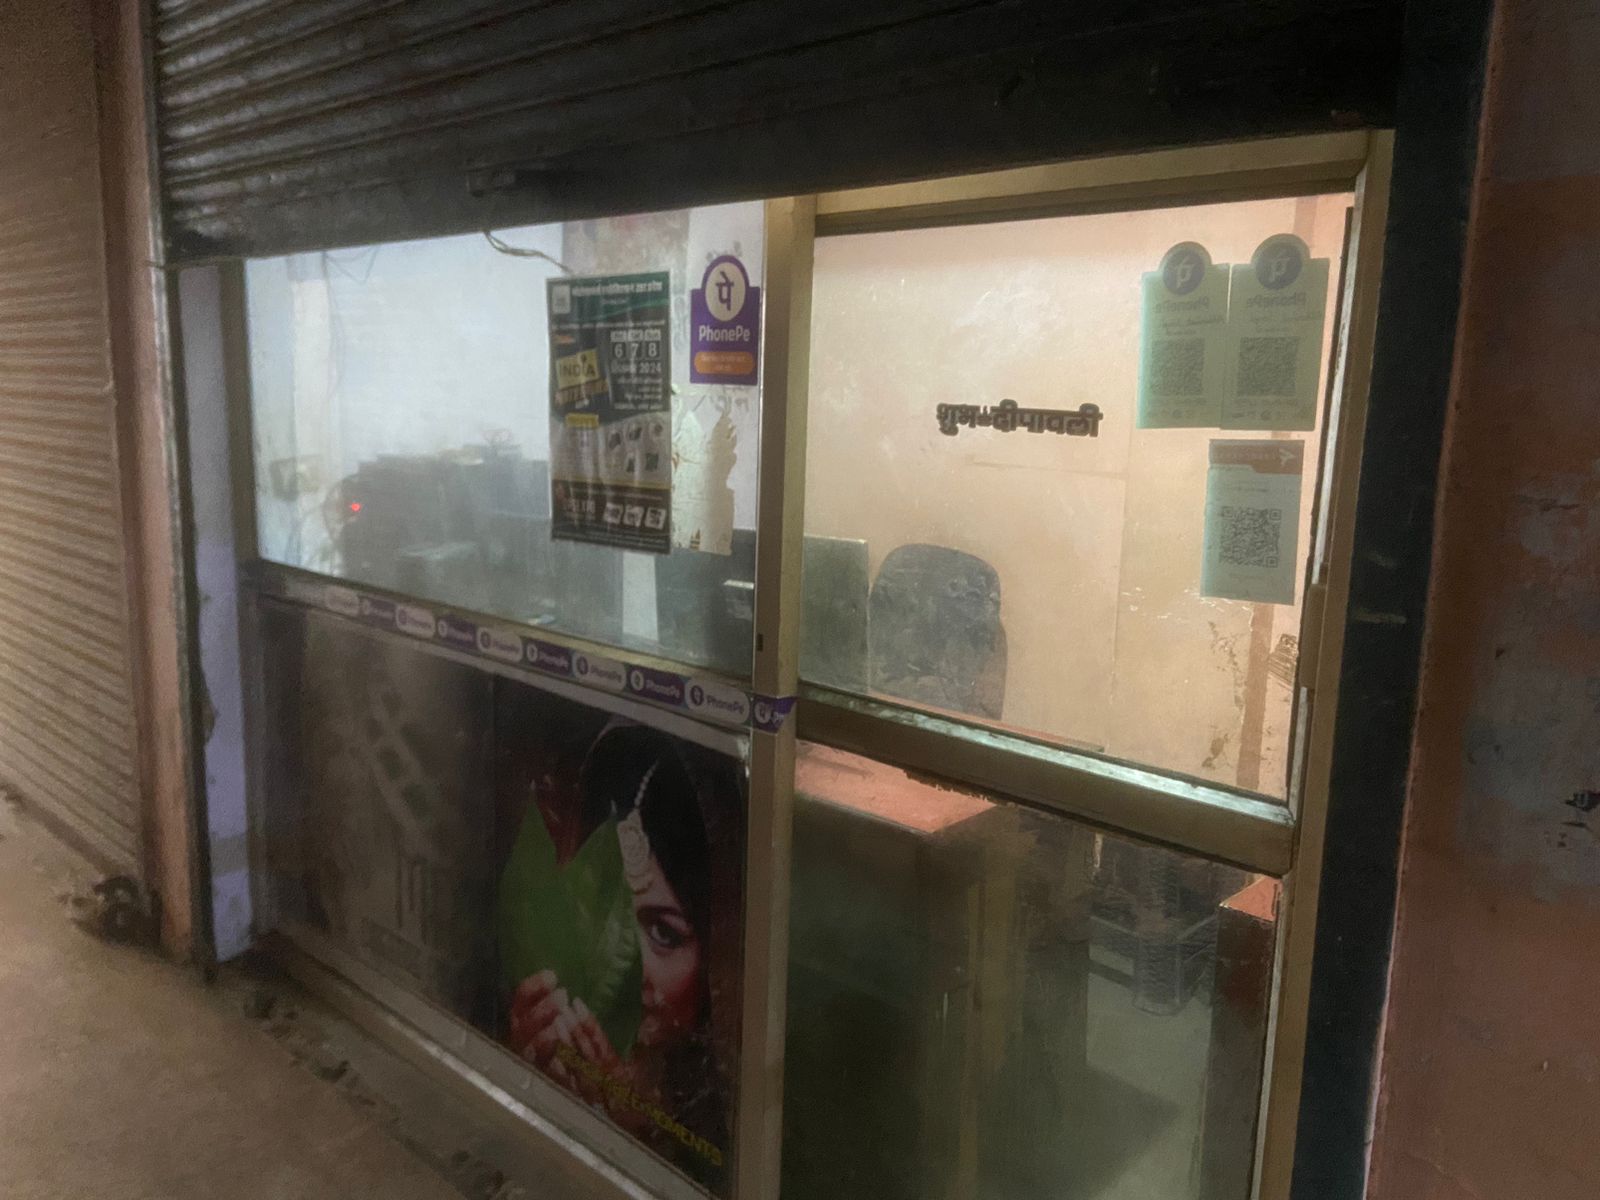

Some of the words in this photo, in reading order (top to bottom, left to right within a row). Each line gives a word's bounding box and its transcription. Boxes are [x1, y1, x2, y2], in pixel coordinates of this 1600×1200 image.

[715, 270, 735, 311] पे
[698, 324, 751, 342] PhonePe
[614, 343, 624, 358] 6
[630, 342, 639, 358] 7
[647, 342, 658, 358] 8
[936, 402, 981, 437] शुभ
[990, 398, 1104, 438] दीपावली
[706, 693, 745, 715] PhonePe
